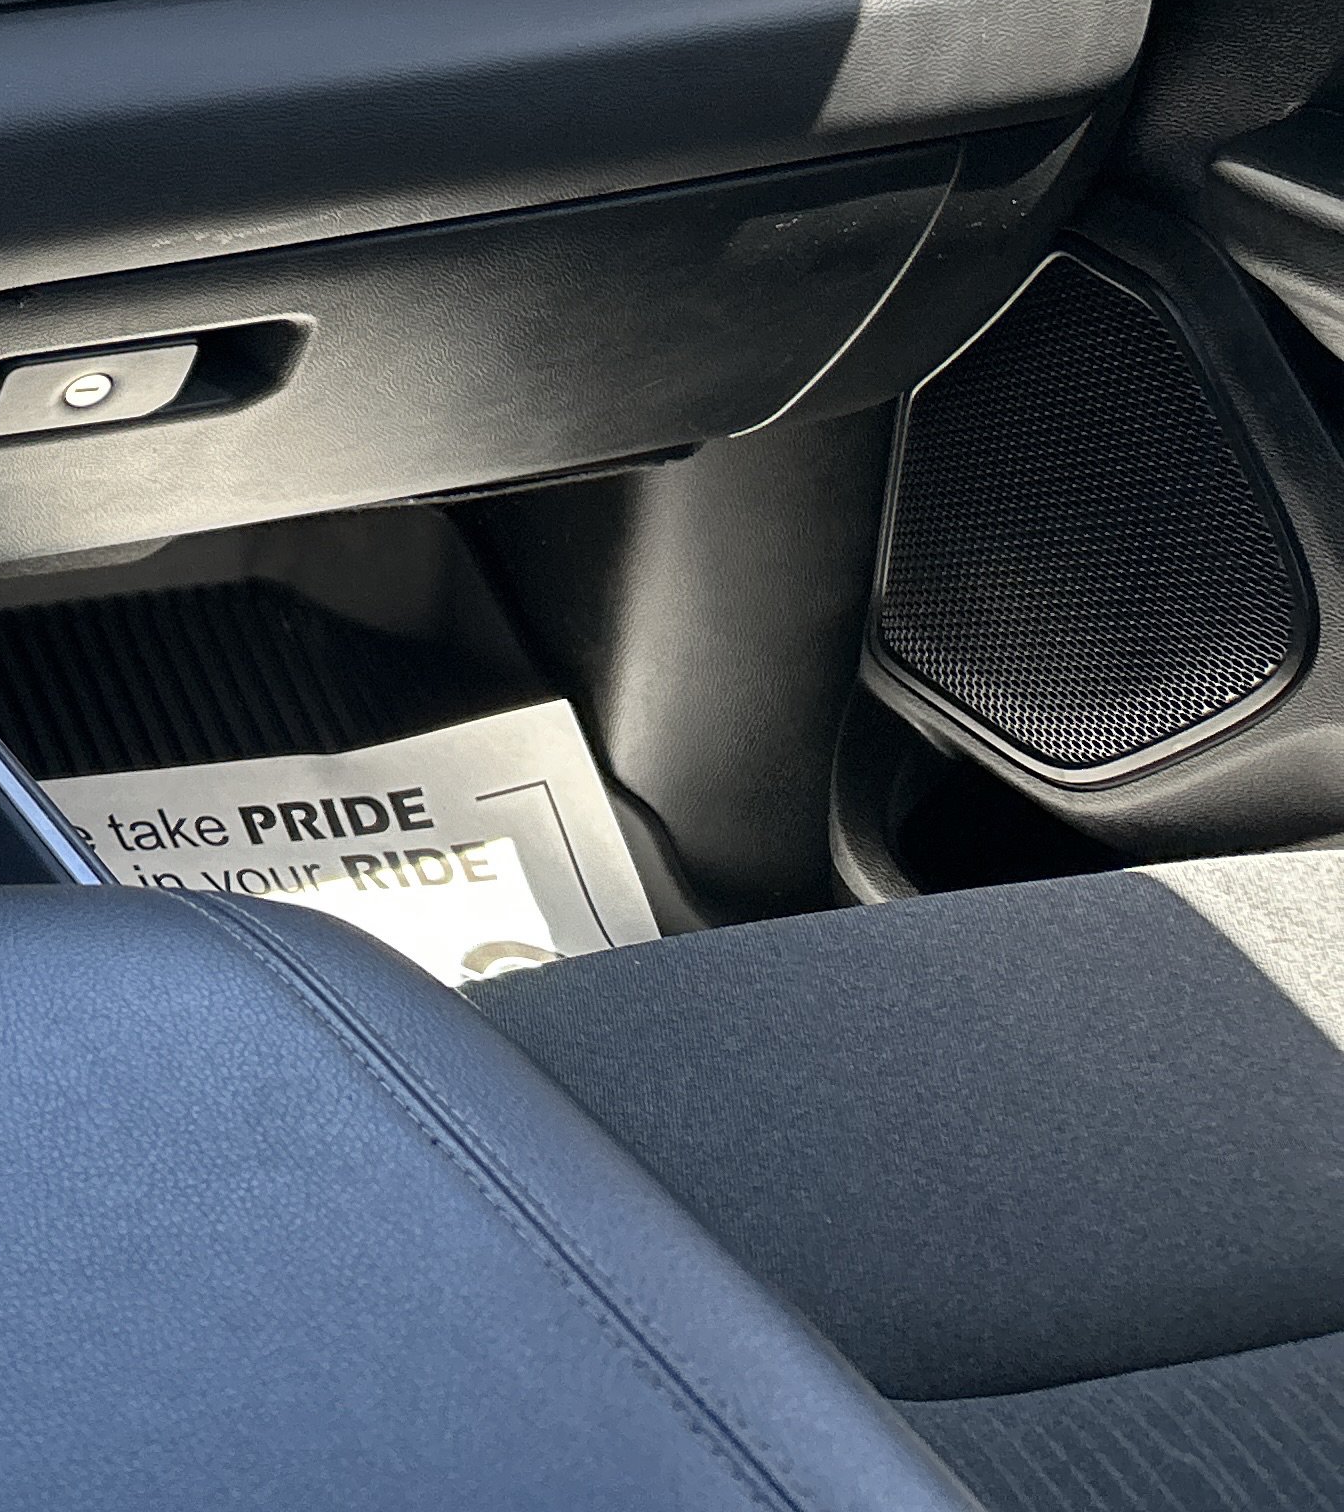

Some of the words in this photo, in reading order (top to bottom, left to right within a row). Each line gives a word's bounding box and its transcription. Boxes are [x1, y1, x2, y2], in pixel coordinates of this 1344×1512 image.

[108, 808, 230, 852] take
[238, 786, 434, 845] PRIDE
[201, 861, 321, 896] your
[340, 840, 499, 891] RIDE
